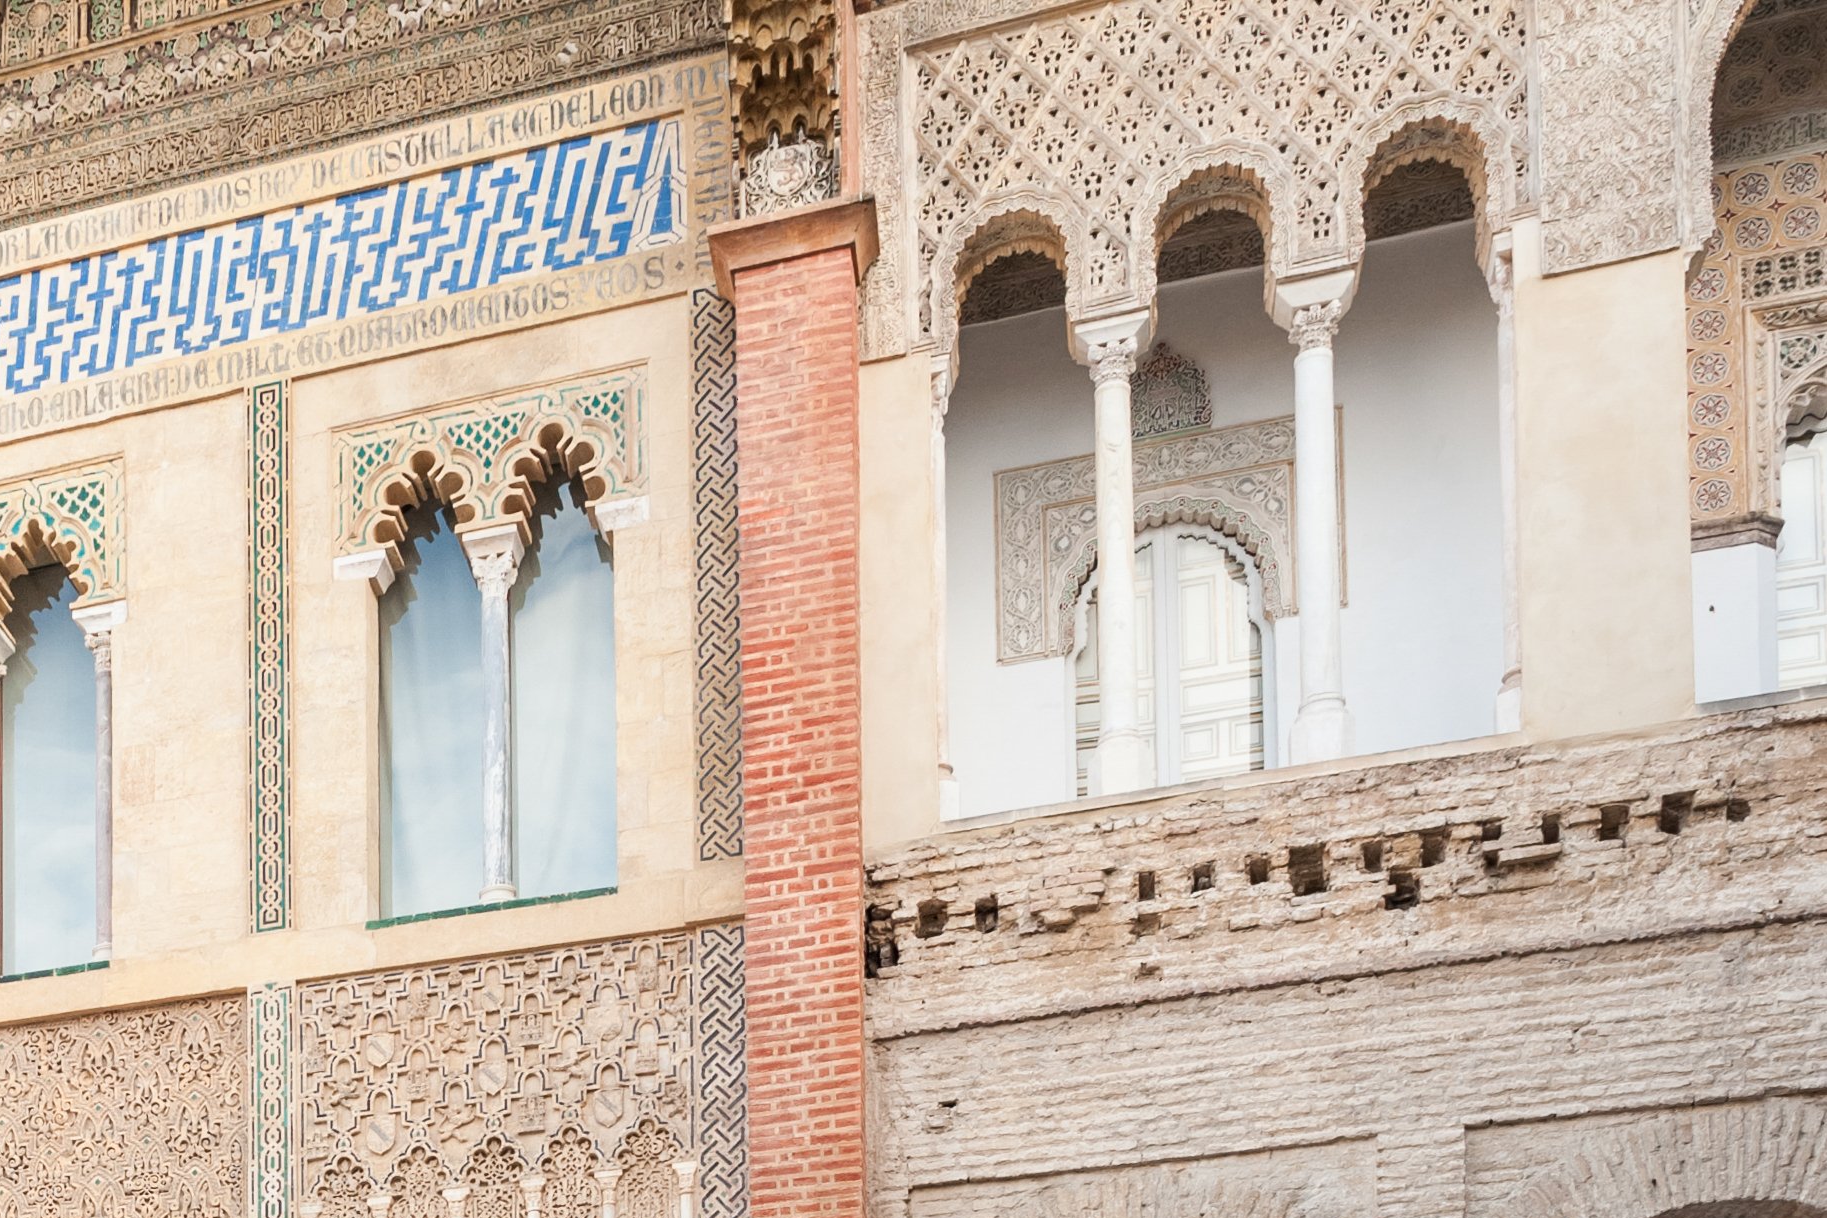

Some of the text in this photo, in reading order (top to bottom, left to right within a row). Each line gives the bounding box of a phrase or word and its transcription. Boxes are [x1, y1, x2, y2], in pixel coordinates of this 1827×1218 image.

[24, 224, 59, 259] LA
[157, 193, 187, 226] DE
[194, 176, 253, 217] DIOS
[258, 164, 305, 201] REY
[311, 153, 343, 188] DE
[549, 94, 582, 131] DE
[588, 74, 665, 122] LEON
[175, 360, 208, 392] DE
